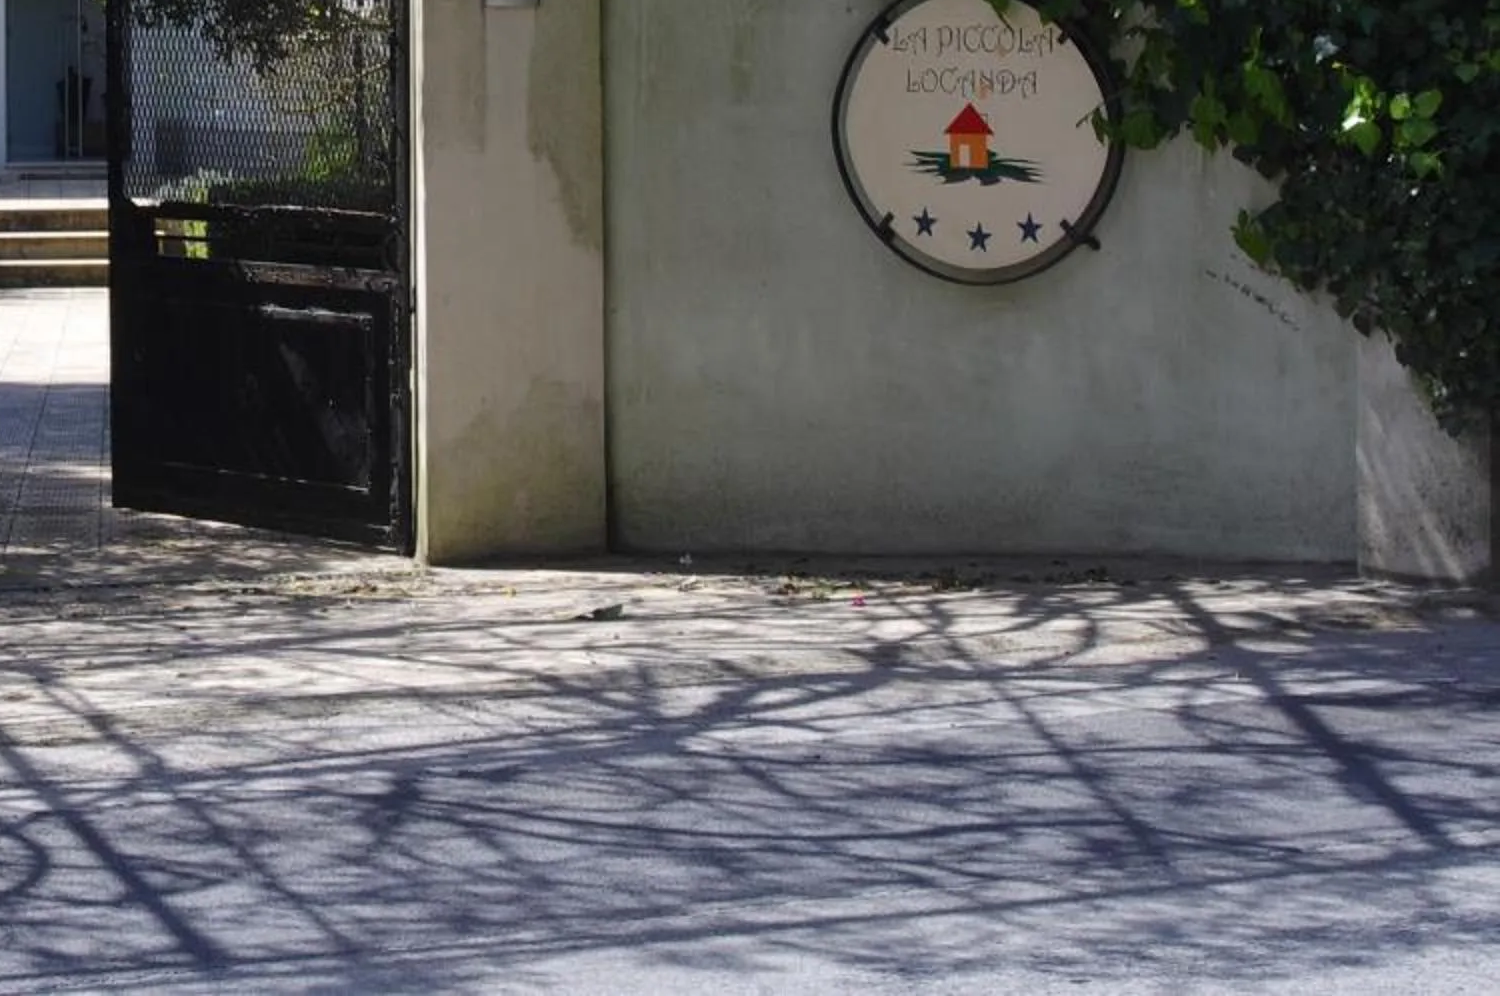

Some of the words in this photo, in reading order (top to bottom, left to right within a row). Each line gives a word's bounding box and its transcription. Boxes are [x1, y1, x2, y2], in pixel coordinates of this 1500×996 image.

[891, 26, 927, 54] LA
[937, 23, 1053, 57] PICCOLA
[905, 66, 1038, 98] LOCANDA
